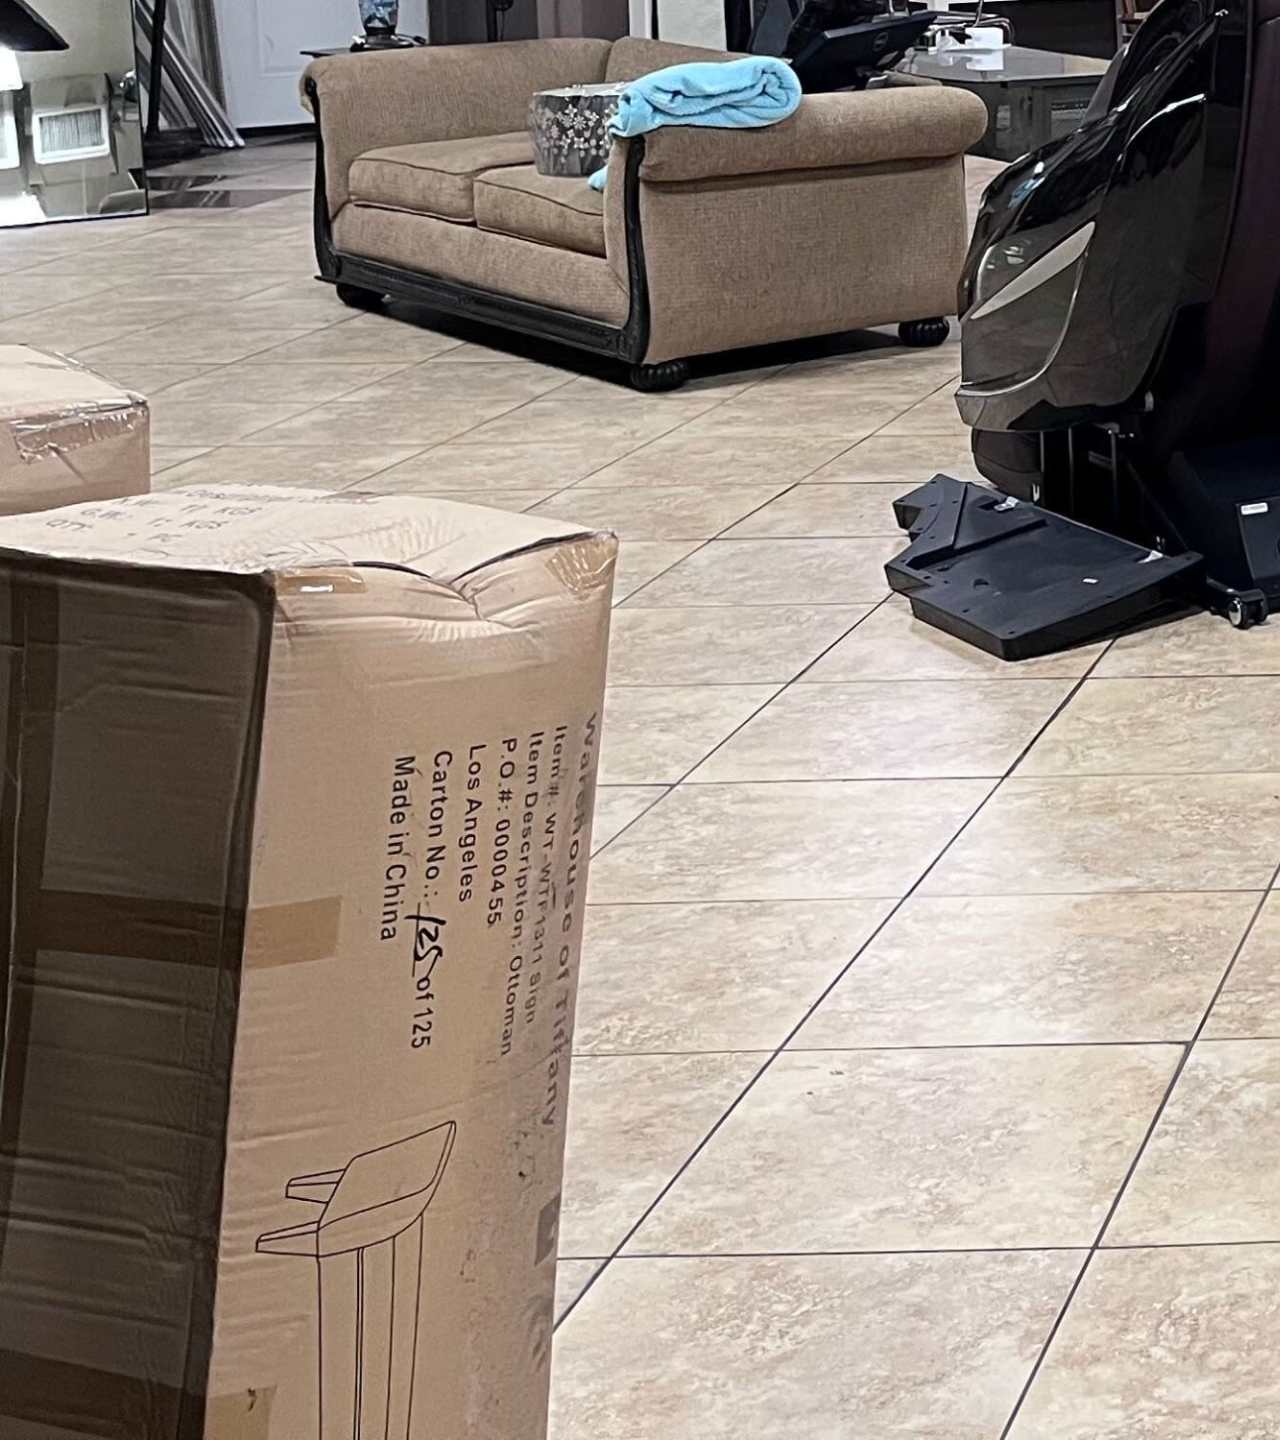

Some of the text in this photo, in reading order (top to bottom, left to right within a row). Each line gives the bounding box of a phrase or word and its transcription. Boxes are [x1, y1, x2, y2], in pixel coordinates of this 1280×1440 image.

[551, 725, 568, 778] Item
[428, 750, 454, 839] Carton
[458, 744, 488, 903] Los Angeles
[380, 755, 416, 941] Made in China
[487, 737, 518, 928] P.O.#: 0000455
[424, 844, 447, 899] No.:
[501, 732, 544, 1056] Item Description: Ottoman
[415, 976, 435, 1001] of
[557, 944, 571, 981] of
[411, 1008, 434, 1049] 125
